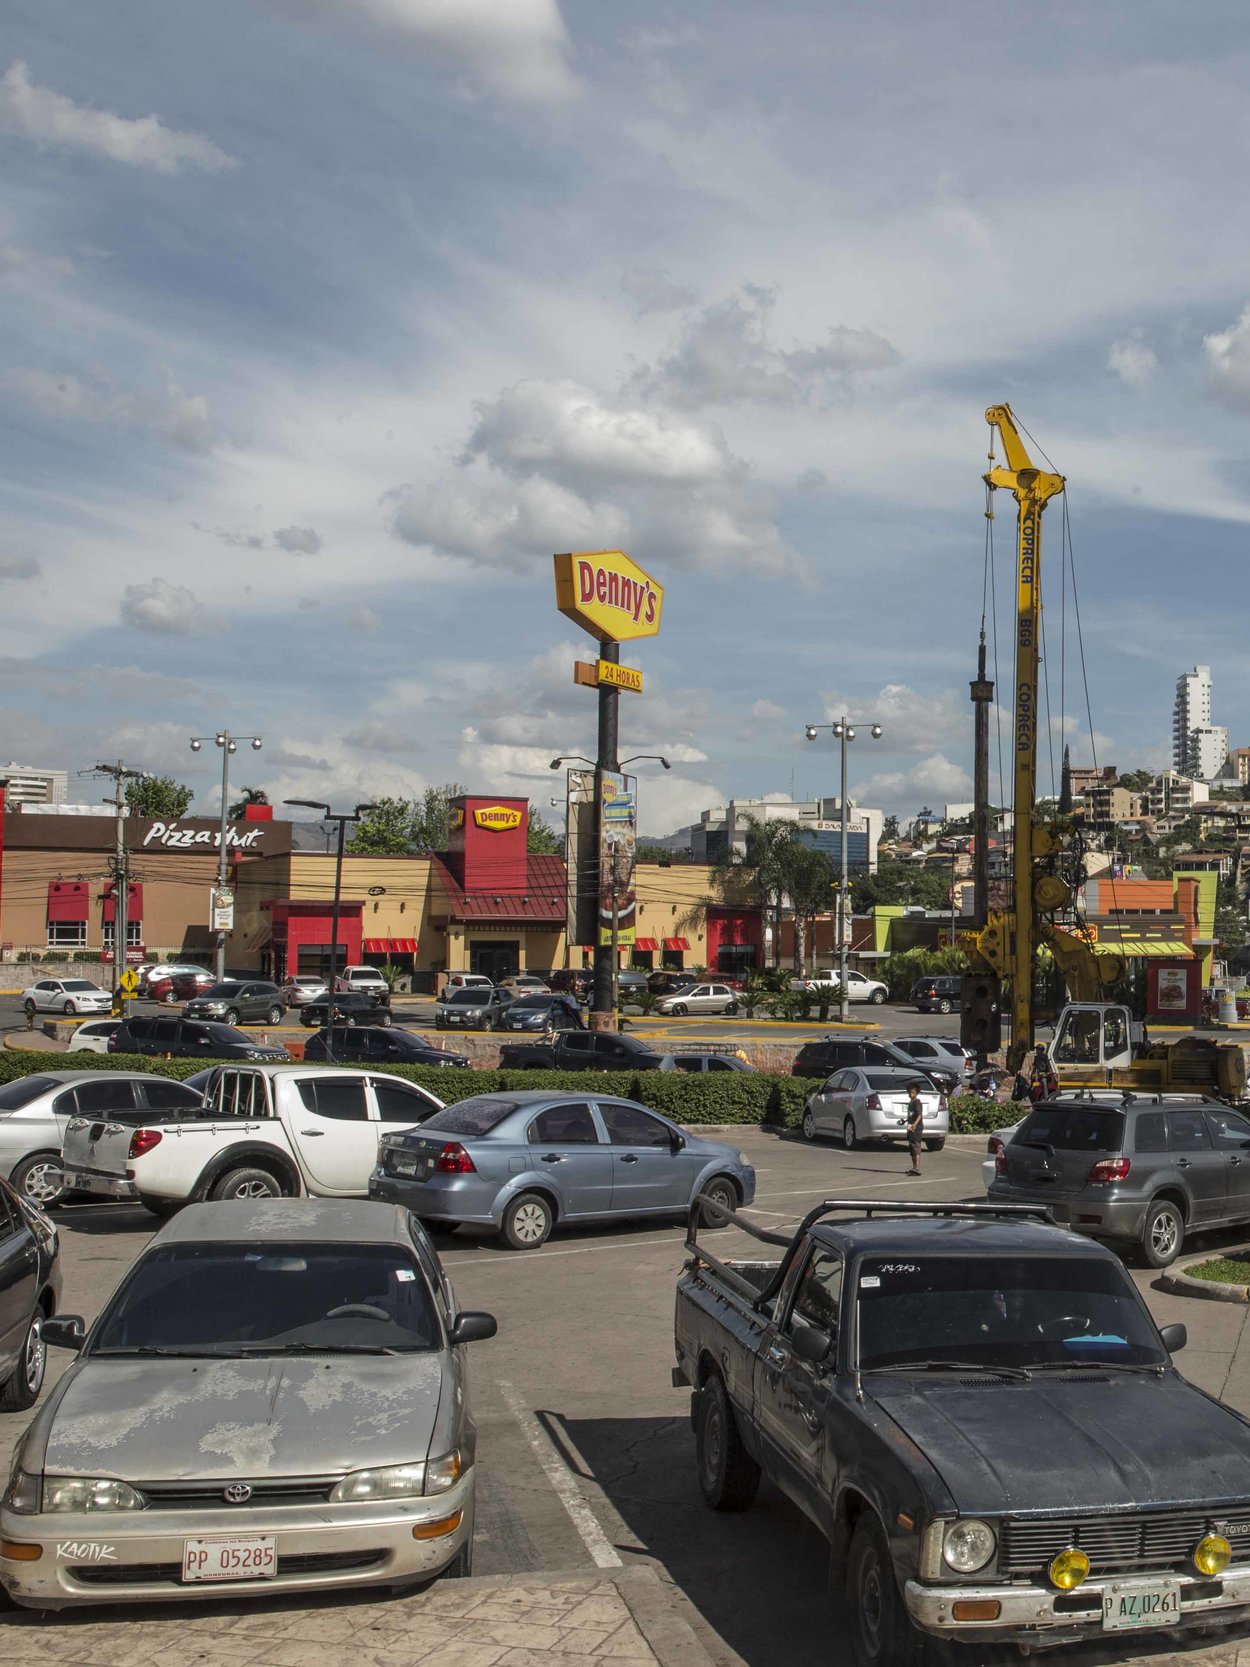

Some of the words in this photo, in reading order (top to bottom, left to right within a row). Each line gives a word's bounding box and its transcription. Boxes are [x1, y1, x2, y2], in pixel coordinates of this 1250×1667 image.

[1021, 517, 1035, 584] COPRECA
[578, 560, 657, 624] Denny's
[1020, 619, 1032, 647] BG9
[604, 665, 614, 680] 24
[615, 667, 641, 688] HORAS
[1017, 682, 1031, 751] COPRECA
[480, 812, 518, 824] Denny's
[142, 821, 211, 848] Pizza
[213, 825, 264, 848] Hut
[56, 1541, 118, 1561] KAOTIK
[187, 1550, 208, 1570] PP
[220, 1547, 273, 1569] 05285
